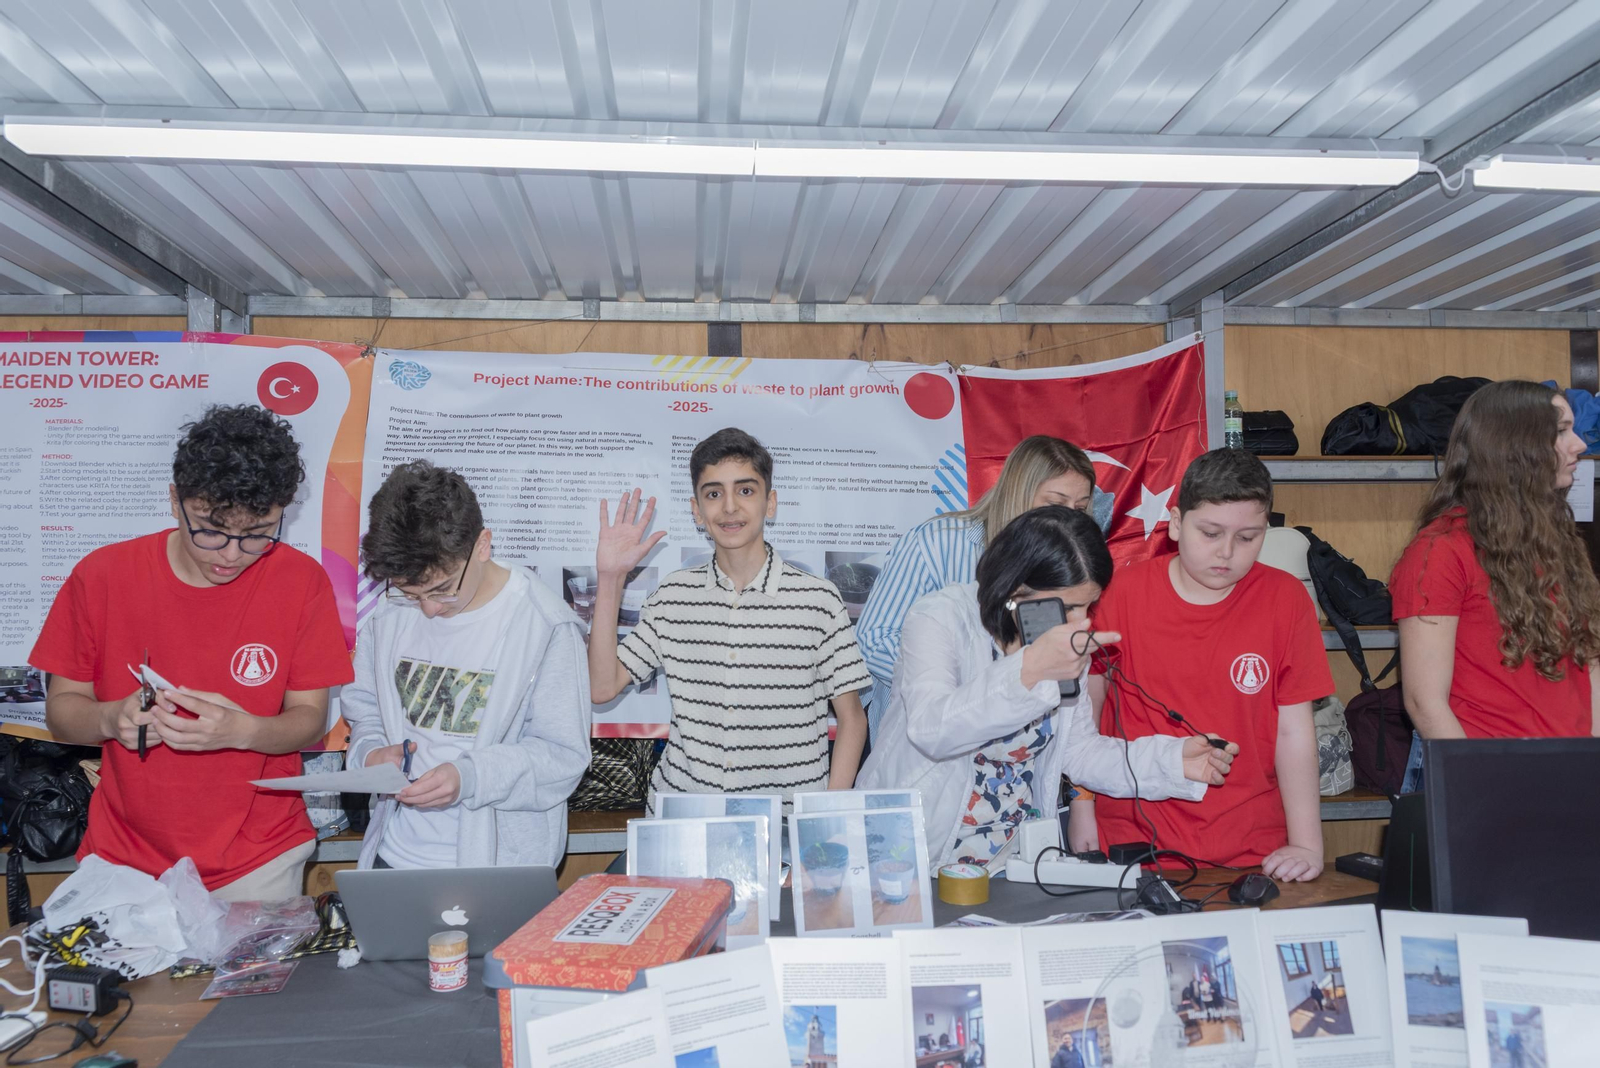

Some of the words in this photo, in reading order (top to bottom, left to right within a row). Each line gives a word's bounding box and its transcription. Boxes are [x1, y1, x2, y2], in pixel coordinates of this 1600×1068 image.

[77, 351, 159, 366] TOWER:
[78, 374, 144, 388] VIDEO
[149, 374, 209, 389] GAME
[474, 372, 530, 388] Project
[616, 378, 718, 393] contributions
[722, 382, 738, 394] of
[742, 384, 785, 395] waste
[790, 384, 804, 396] to
[809, 384, 845, 399] plant
[850, 383, 900, 398] growth
[29, 398, 68, 408] -2025-
[668, 401, 714, 413] -2025-
[390, 406, 413, 415] Project
[62, 489, 92, 497] coloring,
[93, 489, 114, 497] expert
[105, 504, 118, 512] play
[124, 504, 157, 512] accordingly.
[395, 660, 496, 734] NIKE
[567, 892, 640, 936] RESQBOX
